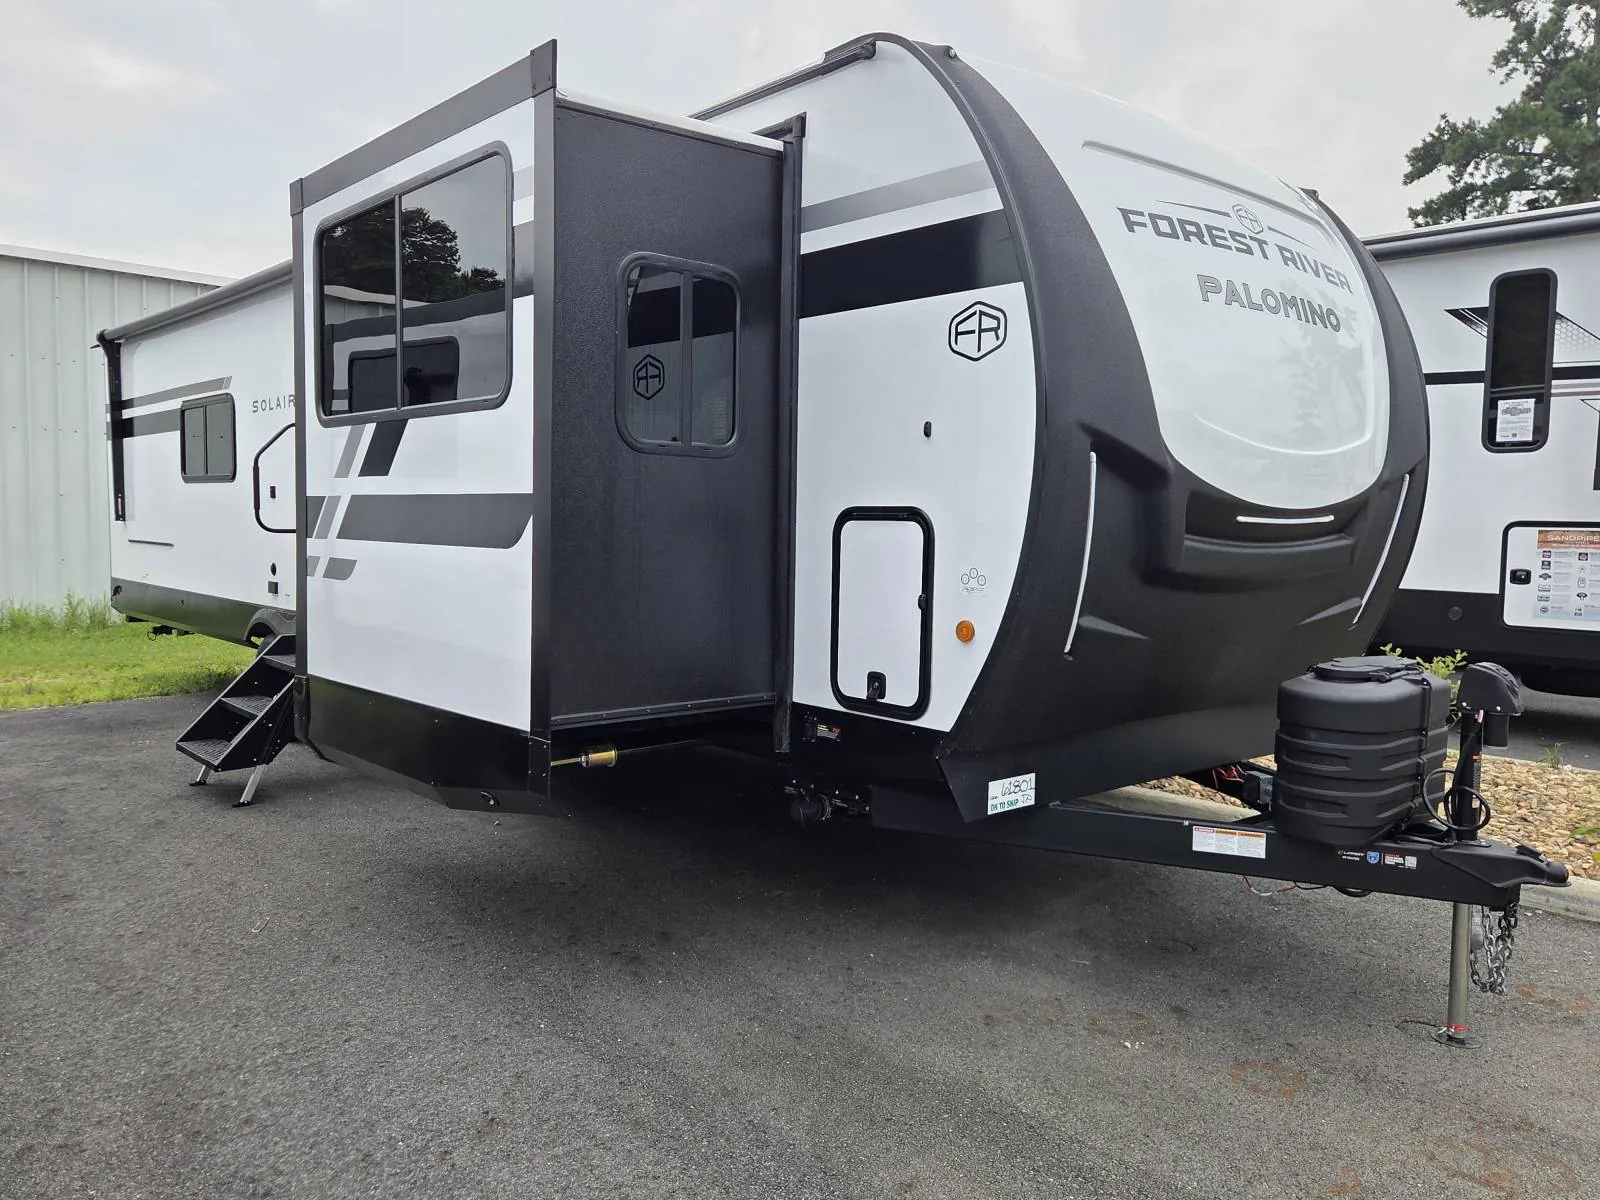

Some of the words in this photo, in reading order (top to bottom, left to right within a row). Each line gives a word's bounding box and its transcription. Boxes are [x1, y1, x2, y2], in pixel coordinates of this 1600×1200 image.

[1116, 206, 1270, 260] FOREST
[1275, 243, 1354, 295] RIVER
[1196, 273, 1341, 333] PALOMINO
